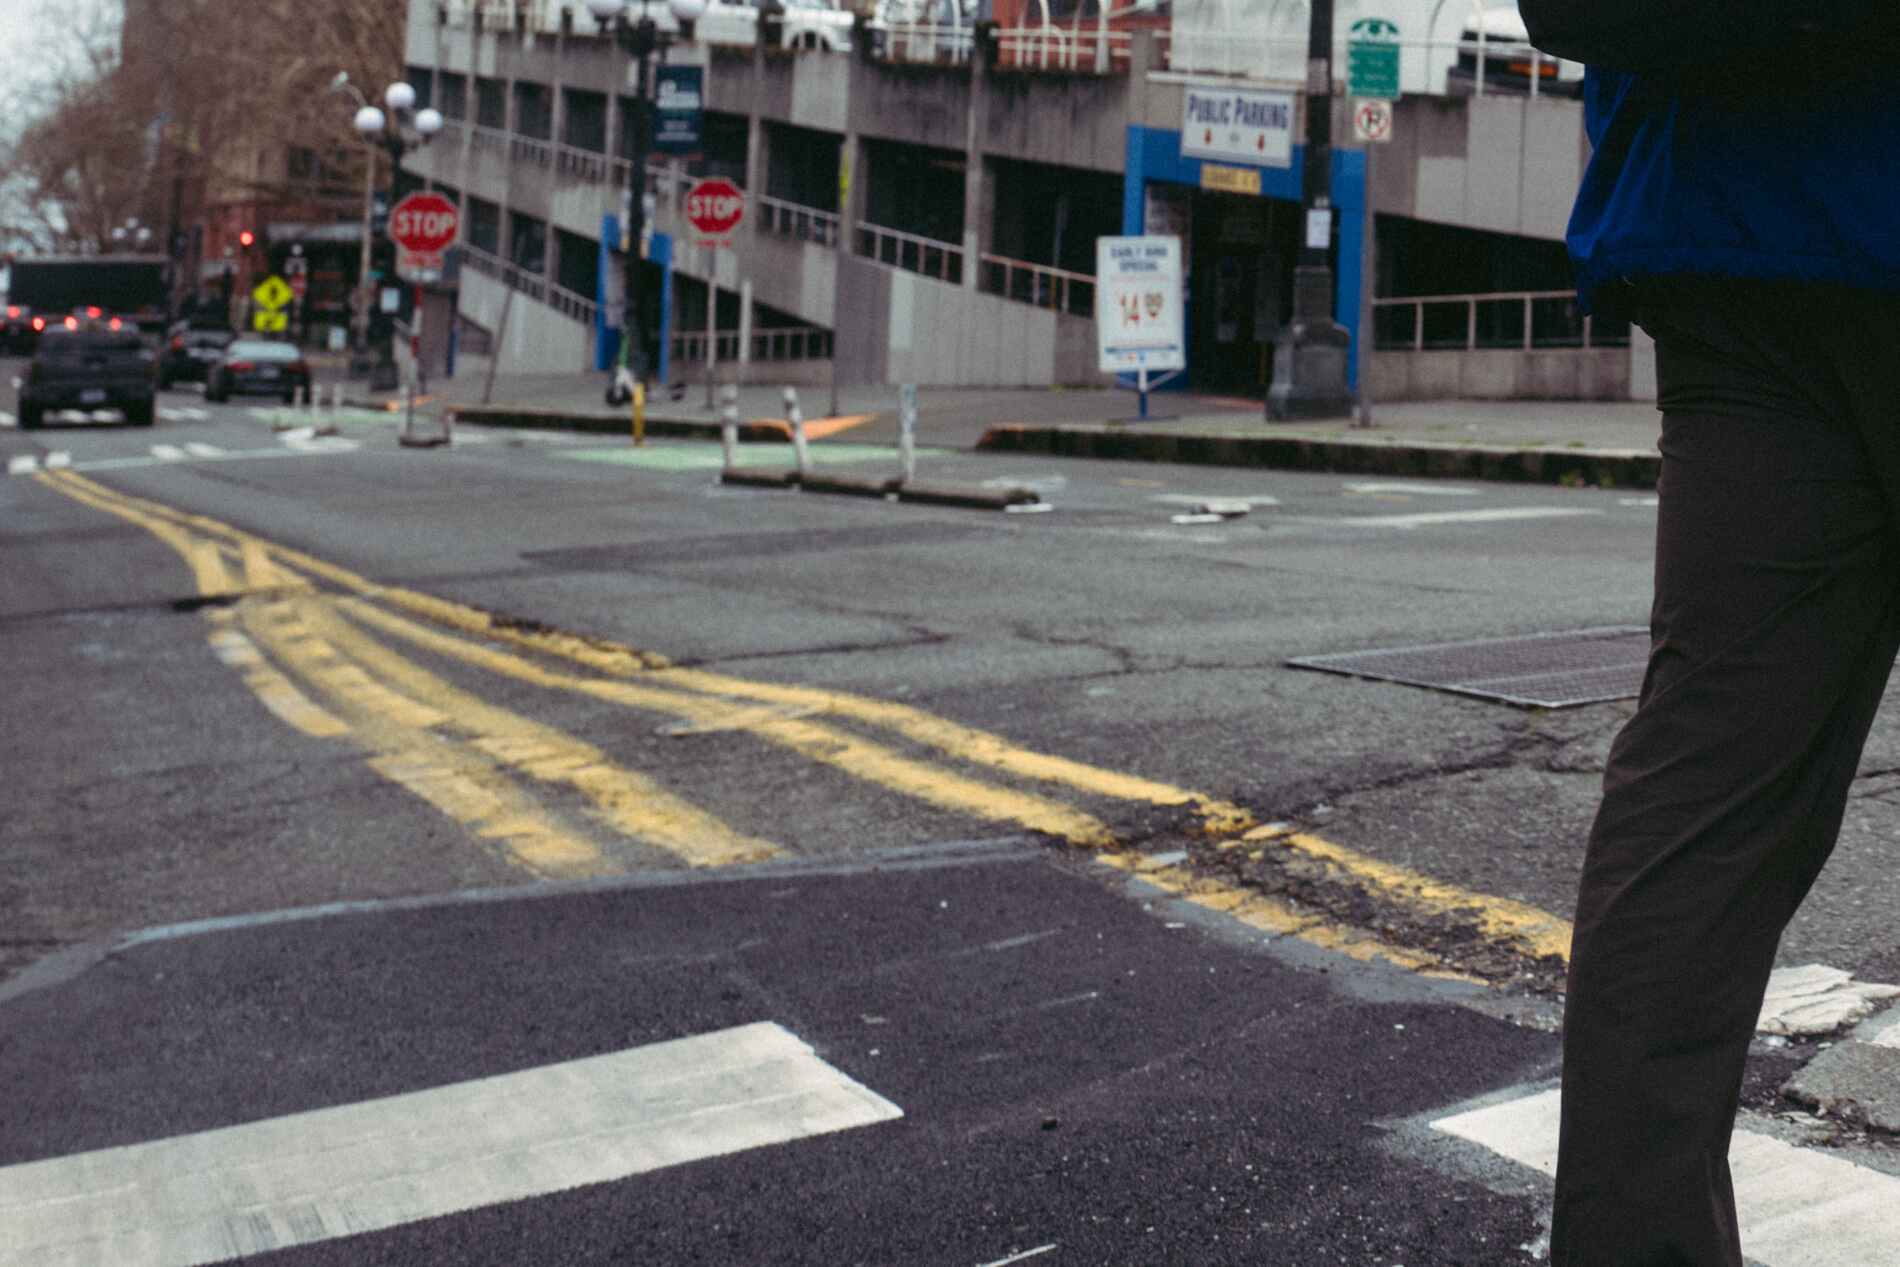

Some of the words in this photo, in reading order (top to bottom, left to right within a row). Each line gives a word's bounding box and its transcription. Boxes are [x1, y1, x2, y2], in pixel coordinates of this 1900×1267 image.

[1187, 94, 1231, 125] PUBLIC
[1234, 96, 1289, 130] PARKING
[691, 195, 741, 220] STOP
[397, 210, 454, 237] STOP
